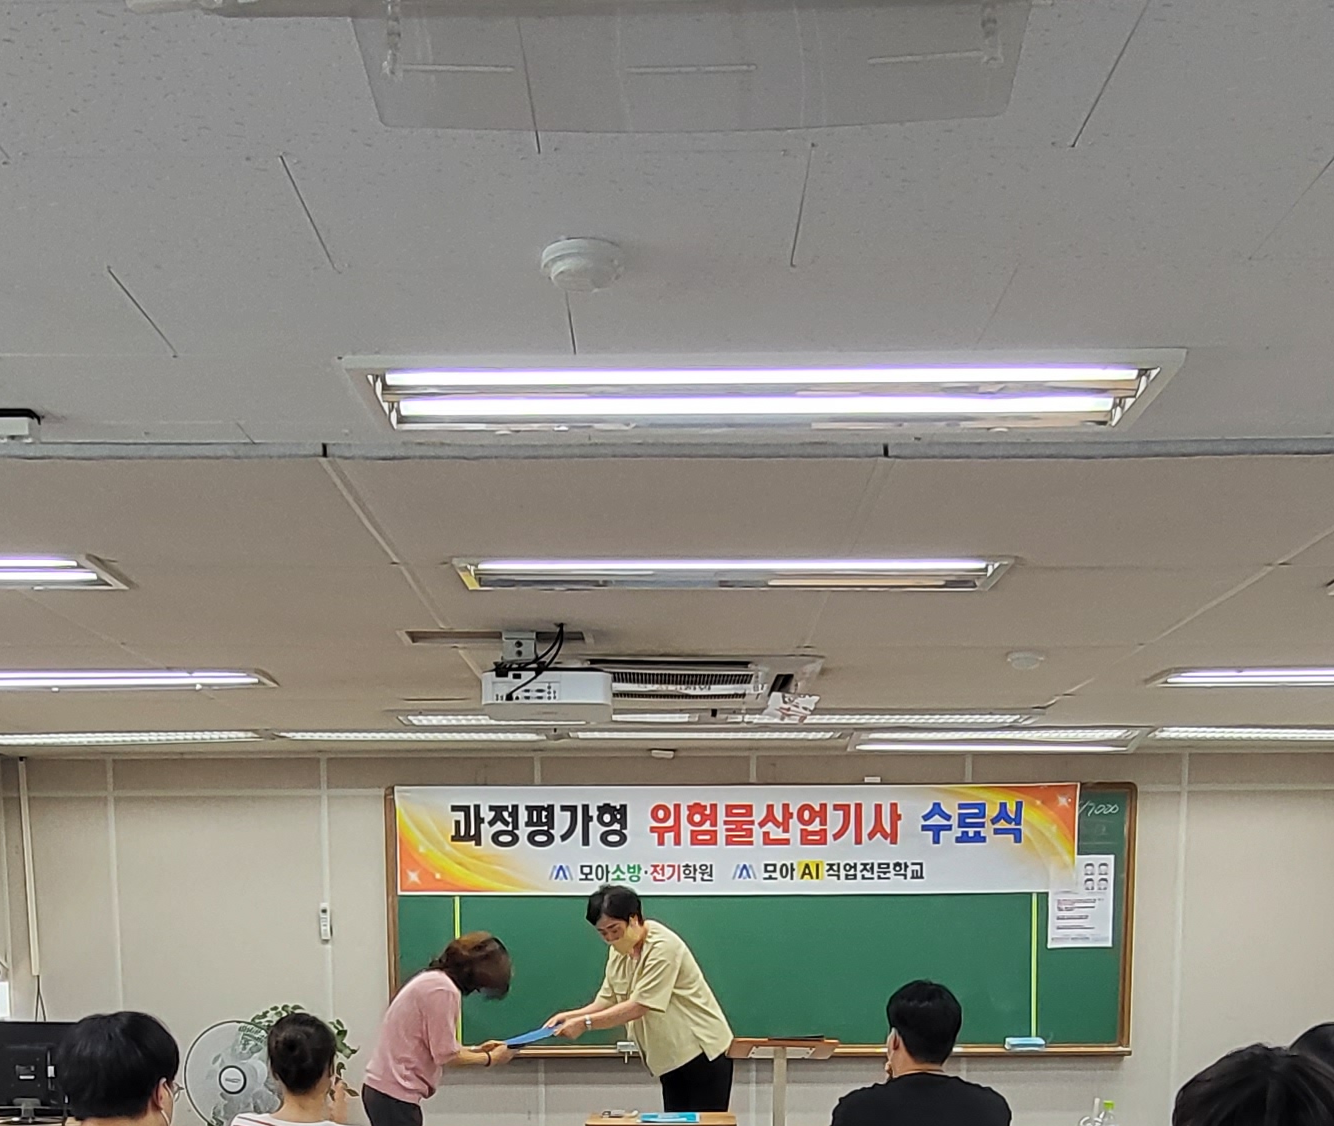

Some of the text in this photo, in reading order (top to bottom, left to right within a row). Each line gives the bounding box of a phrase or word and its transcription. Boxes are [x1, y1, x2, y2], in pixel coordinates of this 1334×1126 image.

[450, 800, 1024, 848] 과정평가형 위험물산업기사 수료식
[578, 863, 714, 883] 모아소방·전기학원
[762, 861, 925, 881] 모아 AI 직업전문학교
